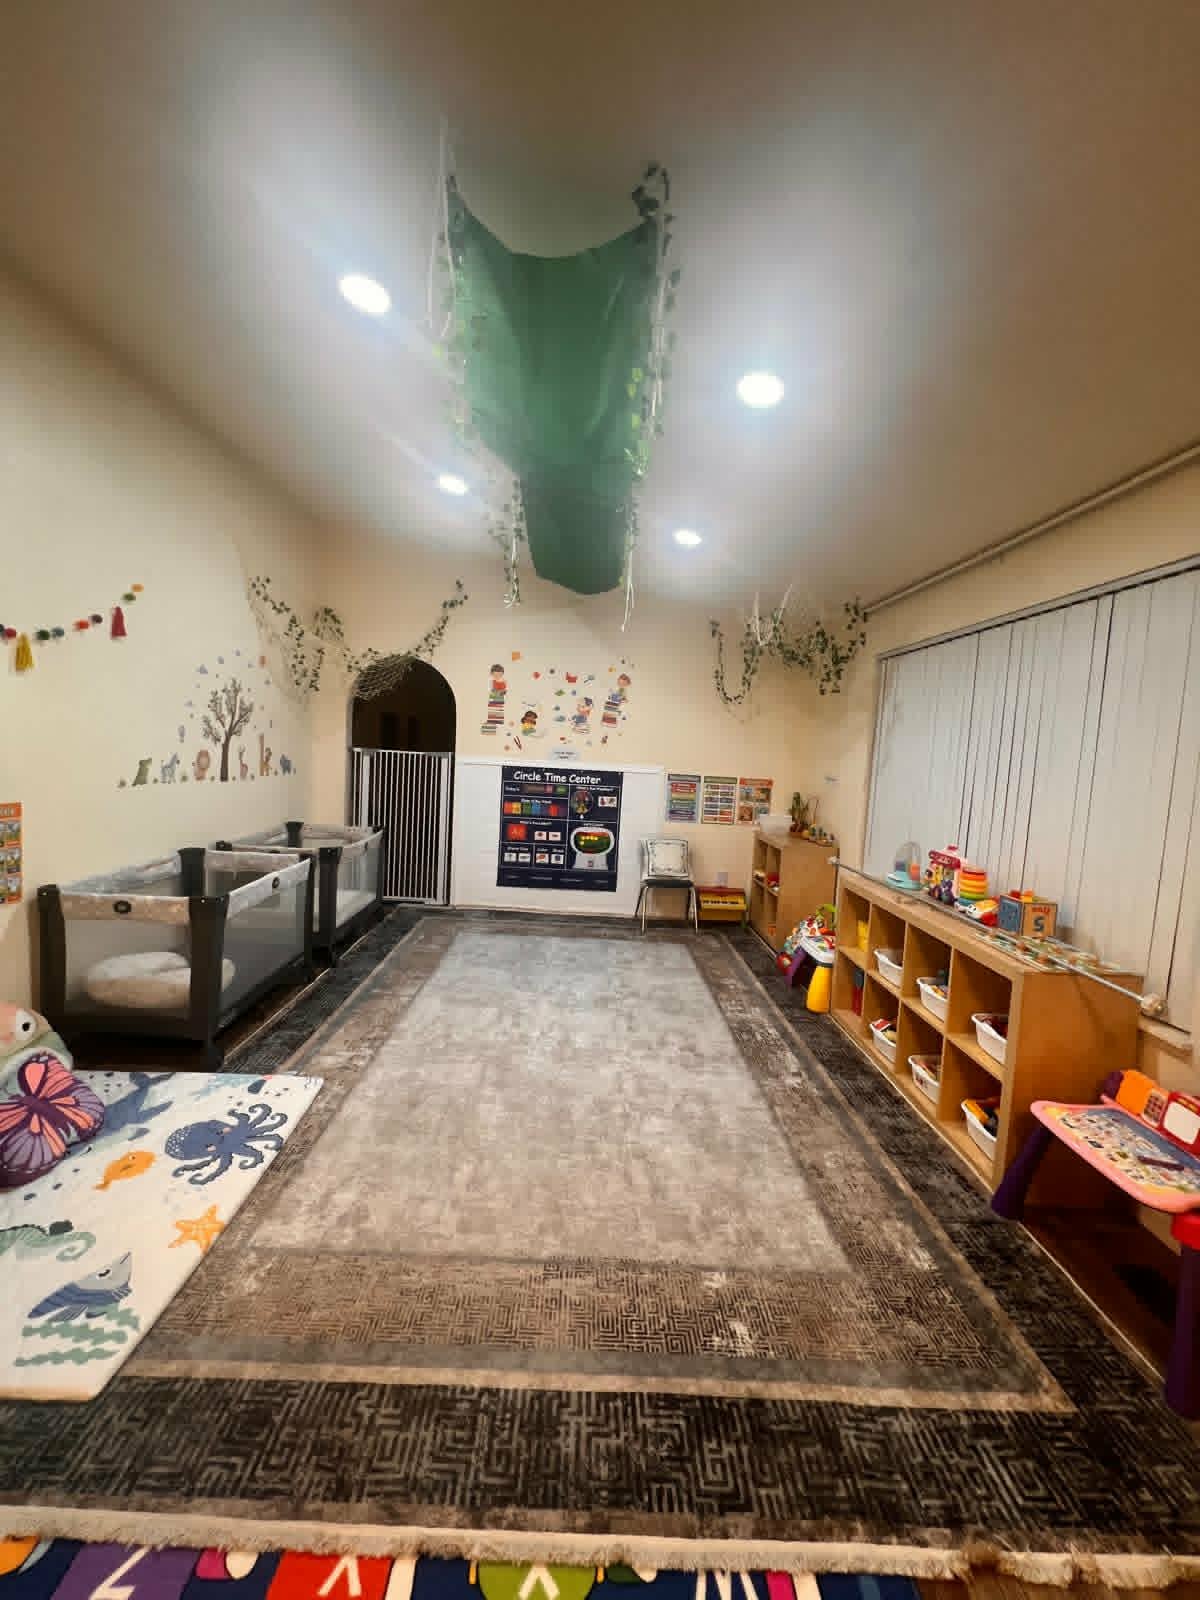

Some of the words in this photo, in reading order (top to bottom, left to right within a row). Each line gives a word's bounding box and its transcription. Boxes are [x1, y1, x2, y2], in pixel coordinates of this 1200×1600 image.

[513, 771, 542, 781] Circle
[544, 772, 567, 783] Time
[569, 774, 601, 784] Center
